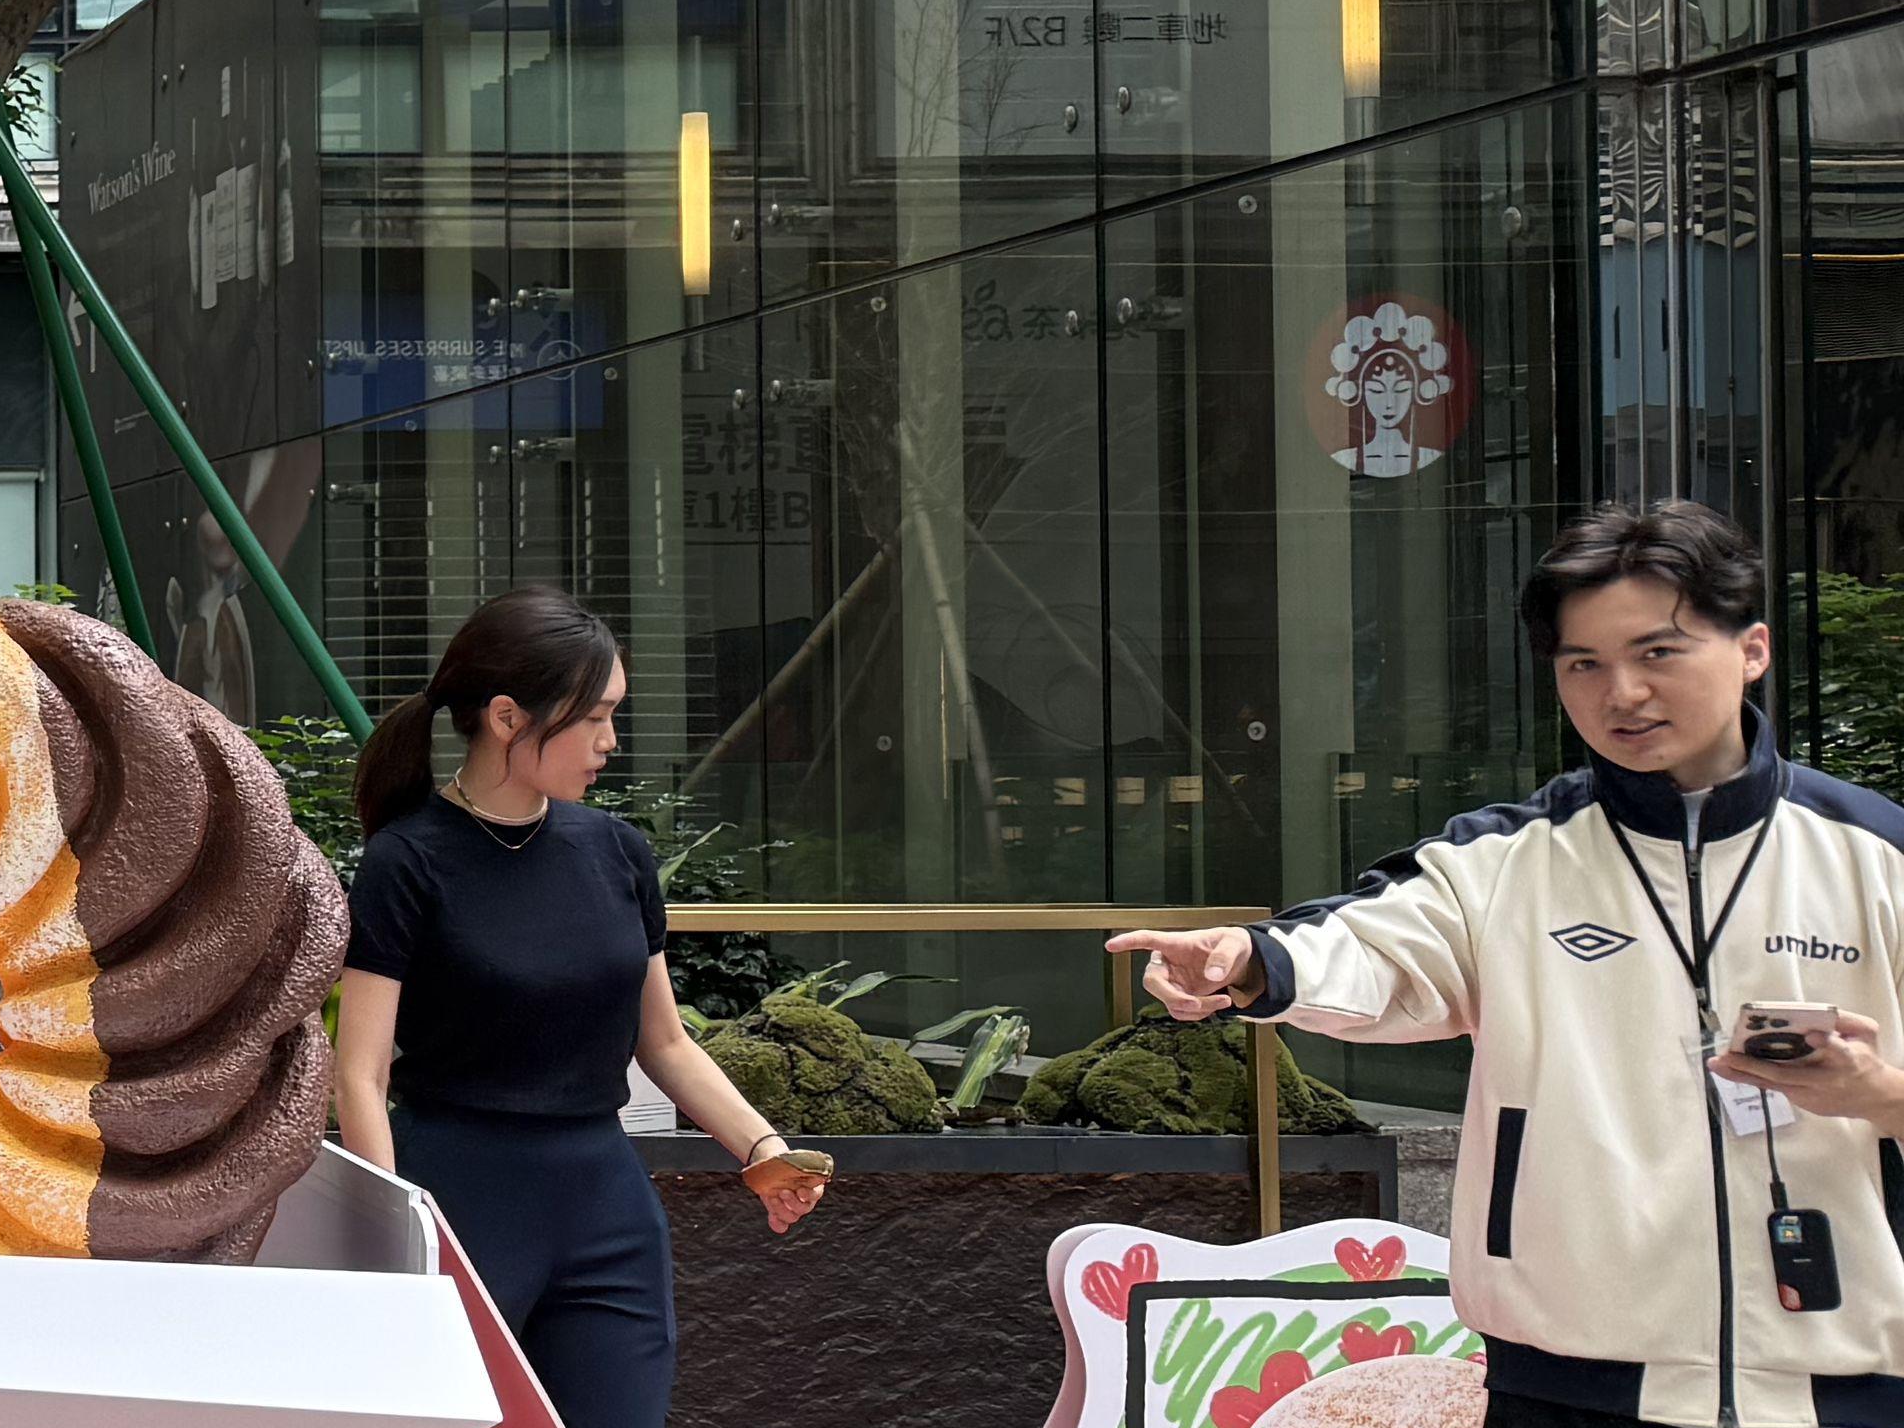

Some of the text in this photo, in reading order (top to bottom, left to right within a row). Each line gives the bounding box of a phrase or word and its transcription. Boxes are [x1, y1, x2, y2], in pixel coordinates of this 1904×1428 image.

[88, 140, 177, 217] Watson's Wine
[1765, 934, 1861, 964] umbro
